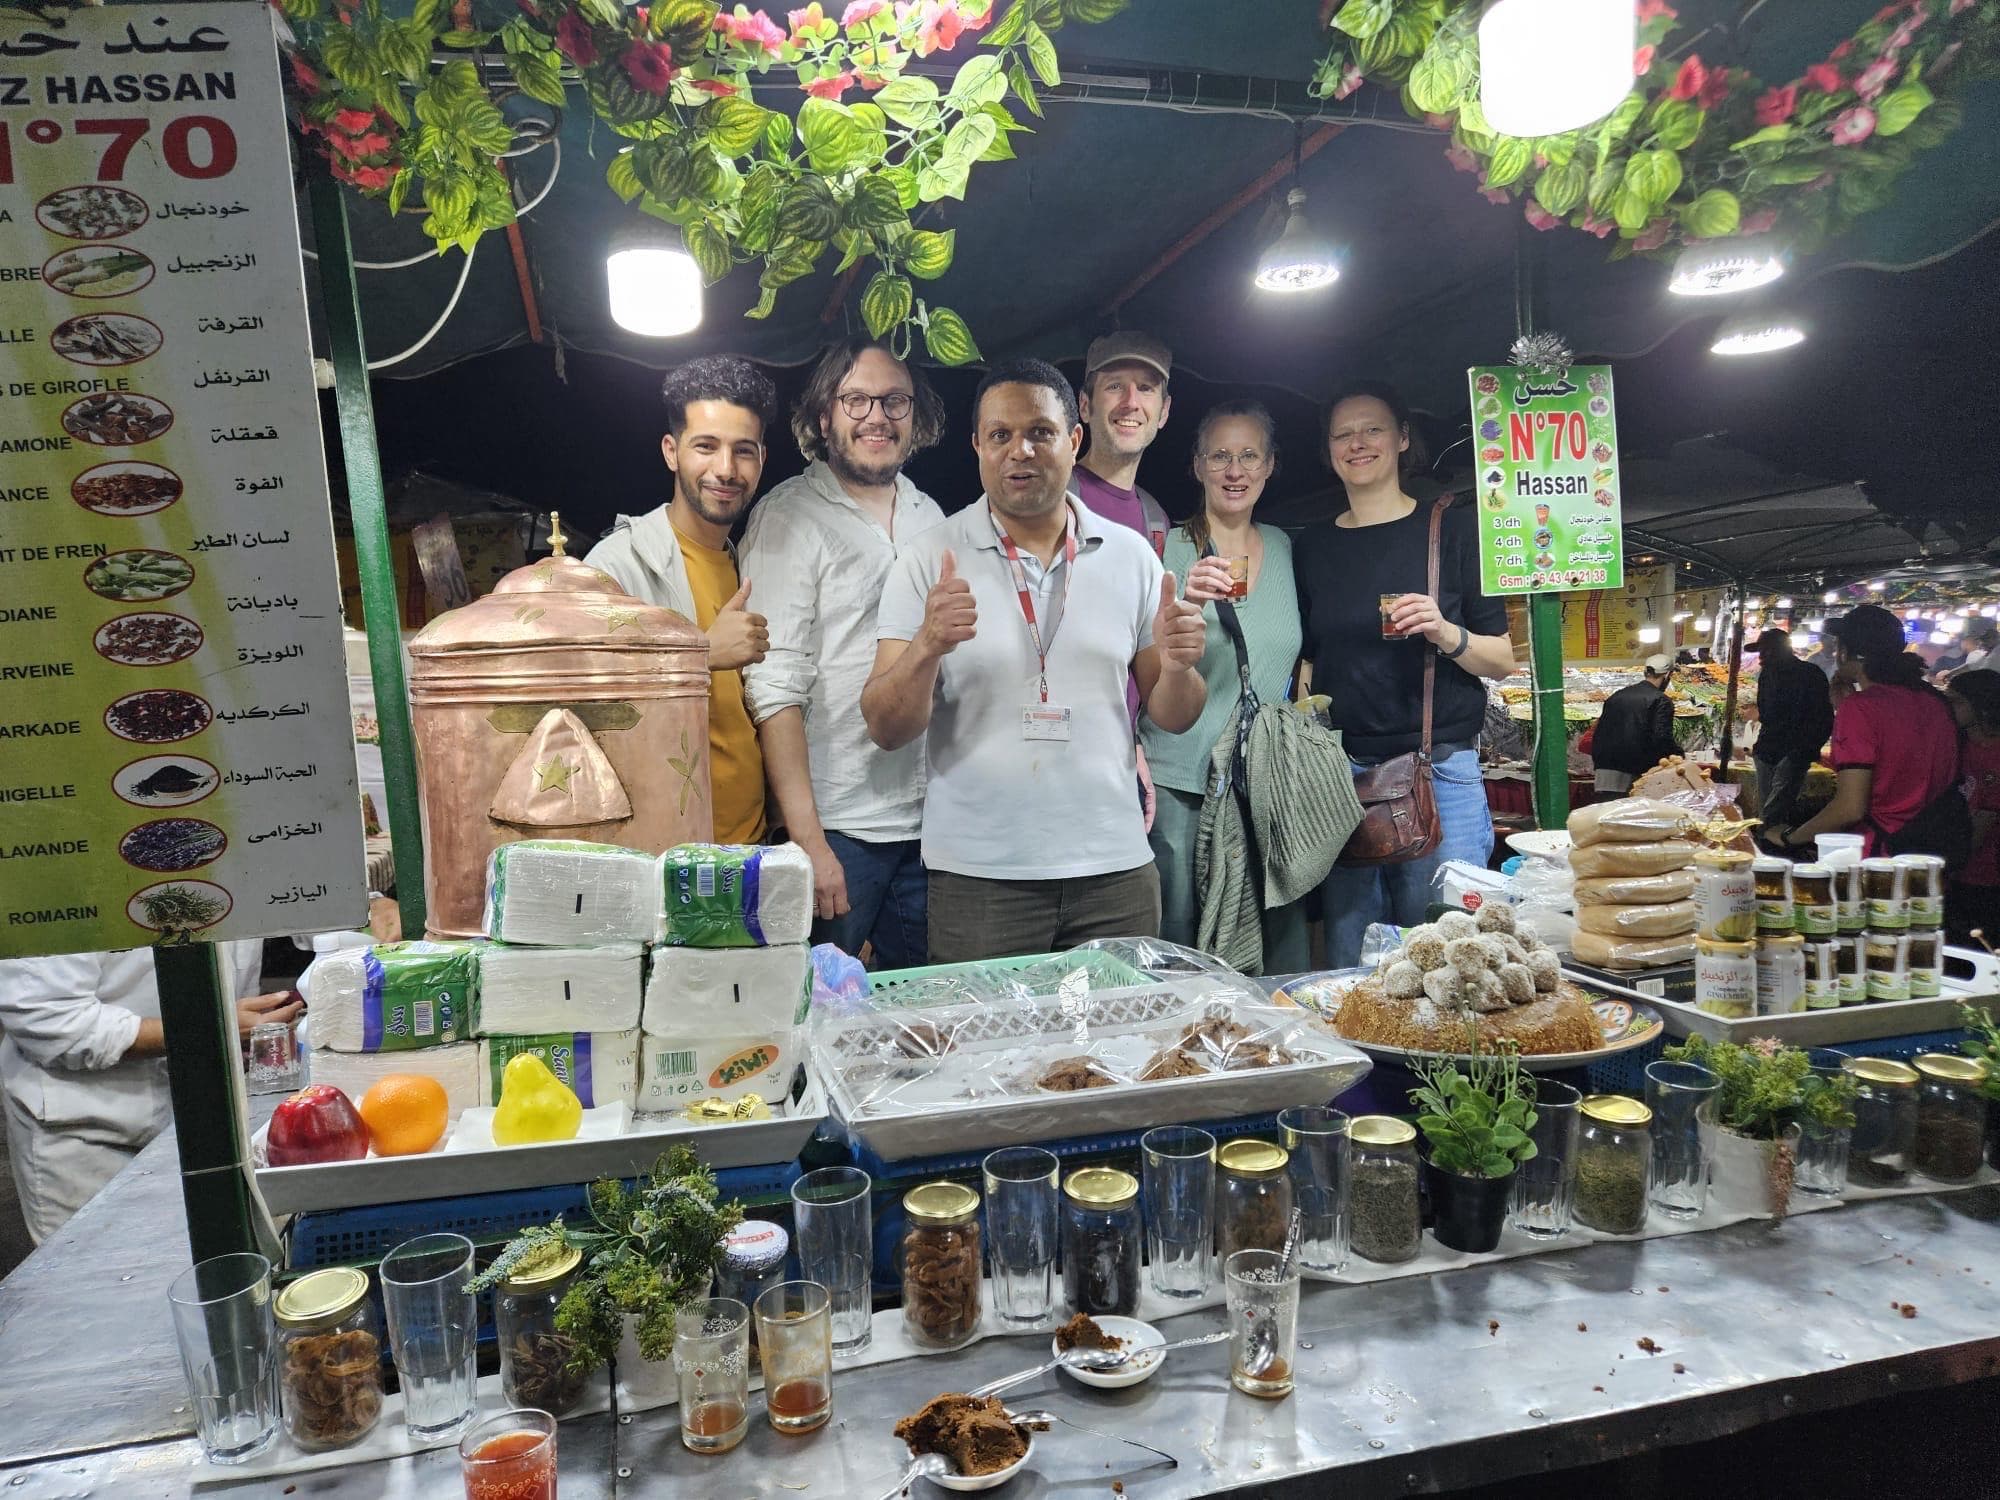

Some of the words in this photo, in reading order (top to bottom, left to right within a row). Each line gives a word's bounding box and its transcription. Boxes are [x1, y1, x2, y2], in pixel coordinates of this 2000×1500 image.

[104, 16, 230, 54] عند
[46, 72, 236, 105] HASSAN
[0, 267, 41, 281] BRE
[198, 316, 264, 333] القرفة
[9, 382, 36, 397] DE
[42, 377, 130, 395] GIROFLE
[193, 369, 270, 388] القرنفل
[211, 425, 279, 443] قعقلة
[1509, 411, 1588, 461] N°70
[0, 436, 73, 454] AMONE
[235, 476, 284, 494] الفوة
[1517, 471, 1588, 496] Hassan
[1494, 517, 1502, 528] 3
[1505, 517, 1521, 528] dh
[189, 530, 238, 552] الطير
[243, 530, 290, 548] لسان
[1495, 537, 1502, 547] 4
[1506, 536, 1522, 547] dh
[23, 547, 49, 561] DE
[55, 543, 107, 559] FREN
[1495, 556, 1503, 567] 7
[1507, 555, 1523, 566] dh
[1500, 574, 1523, 587] Gsm
[1549, 571, 1562, 584] 43
[1579, 571, 1590, 582] 21
[1593, 570, 1605, 582] 38
[0, 606, 57, 623] DIANE
[238, 645, 304, 664] اللويزة
[0, 662, 75, 681] RVEINE
[0, 720, 81, 739] ARKADE
[0, 840, 89, 859] LAVANDE
[8, 905, 98, 925] ROMARIN
